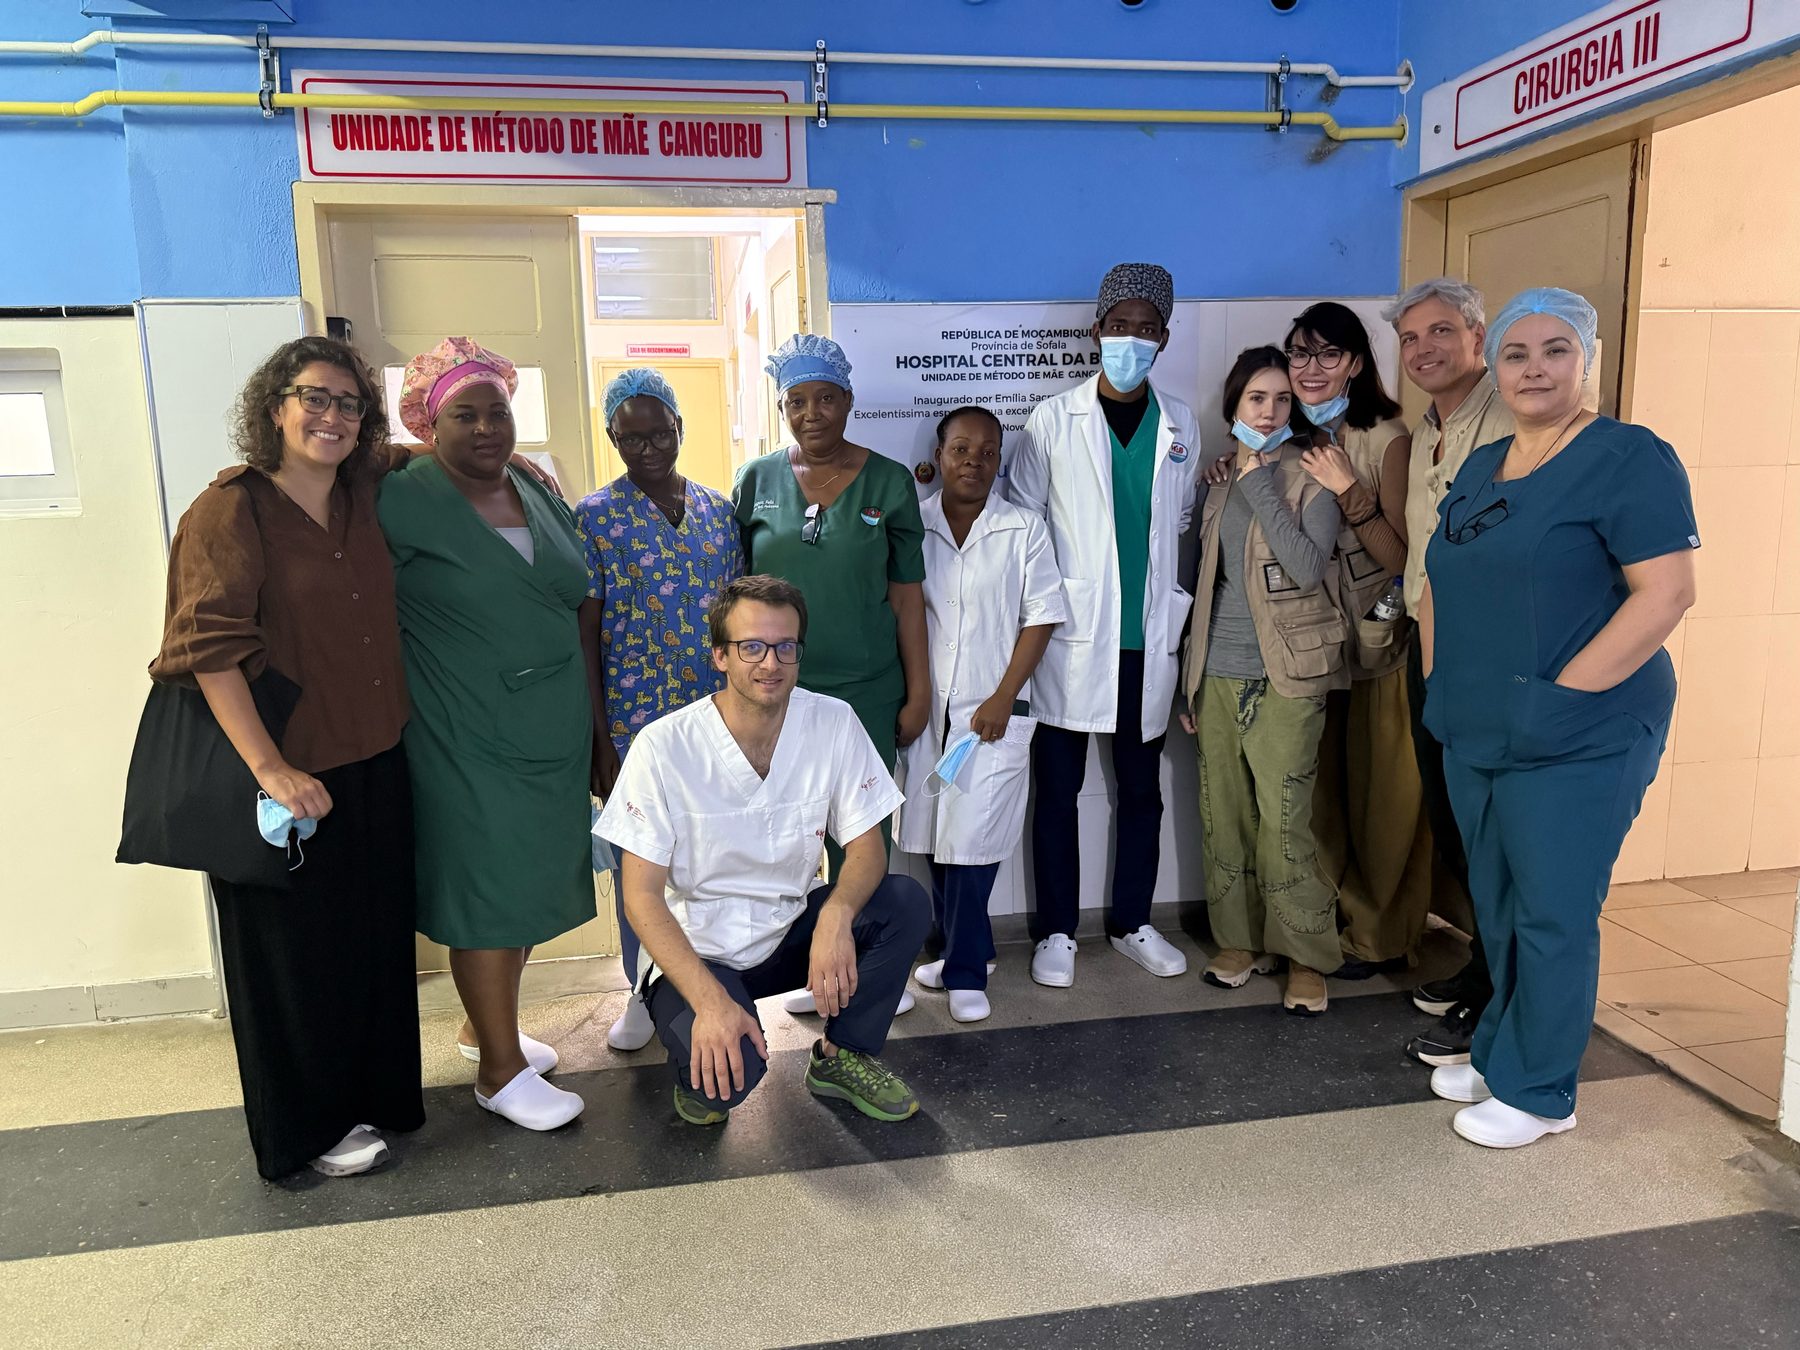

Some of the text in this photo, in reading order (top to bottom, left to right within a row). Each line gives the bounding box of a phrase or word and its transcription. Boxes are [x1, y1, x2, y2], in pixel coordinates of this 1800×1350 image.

[1514, 11, 1661, 115] CIRURGIA III
[331, 112, 763, 158] UNIDADE DE MÉTODO DE MÃE CANGURU
[941, 328, 1002, 340] REPÚBLICA
[1004, 329, 1019, 339] DE
[971, 339, 1067, 351] Província de Sofala
[896, 354, 978, 369] HOSPITAL
[981, 353, 1059, 368] CENTRAL
[1062, 353, 1086, 366] DA
[921, 369, 1099, 382] UNIDADE DE MÉTODO DE MÃE CANG
[913, 395, 973, 406] Inaugurado
[975, 395, 993, 405] por
[995, 393, 1027, 403] Emília
[932, 410, 951, 419] esp
[1002, 423, 1026, 432] Nove
